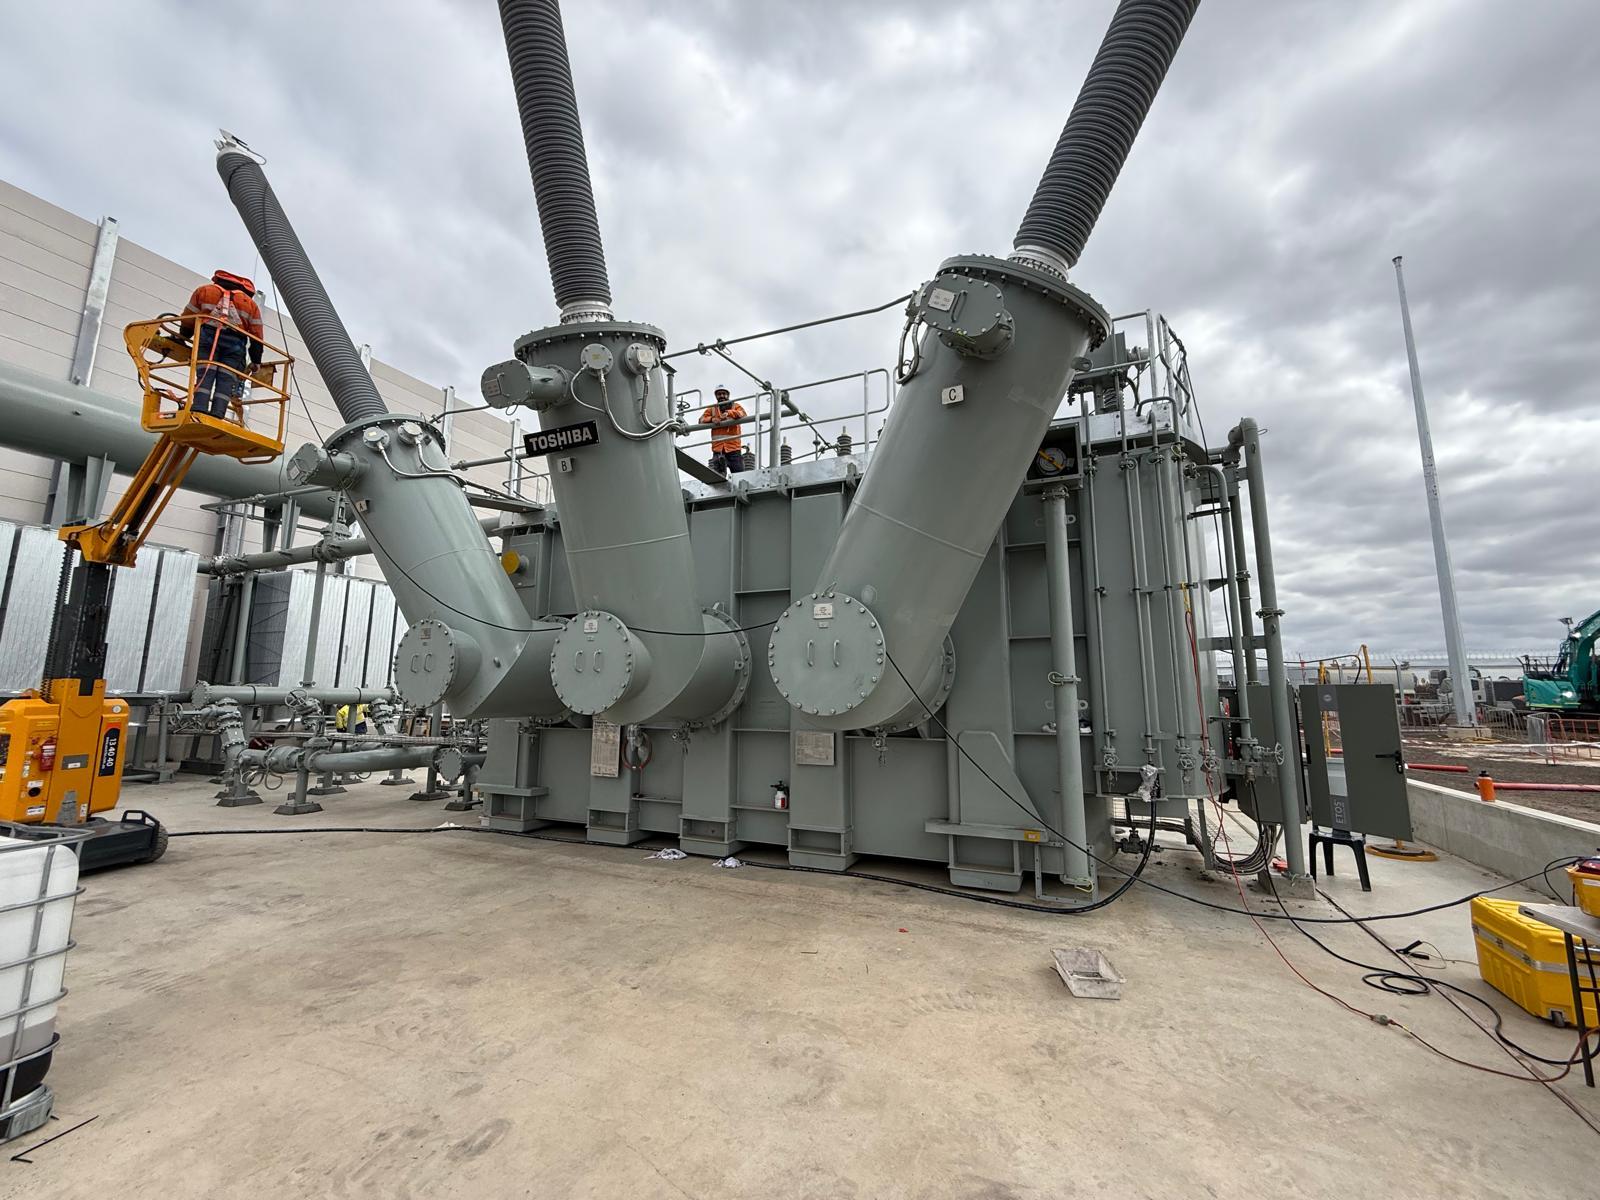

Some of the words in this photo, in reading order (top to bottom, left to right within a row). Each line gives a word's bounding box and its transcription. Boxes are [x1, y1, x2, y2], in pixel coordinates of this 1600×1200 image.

[949, 388, 957, 401] C
[529, 427, 592, 451] TOSHIBA
[561, 461, 567, 471] B
[109, 738, 117, 746] 13
[107, 747, 116, 756] 40
[106, 757, 115, 767] 40
[1334, 801, 1344, 824] ETOS
